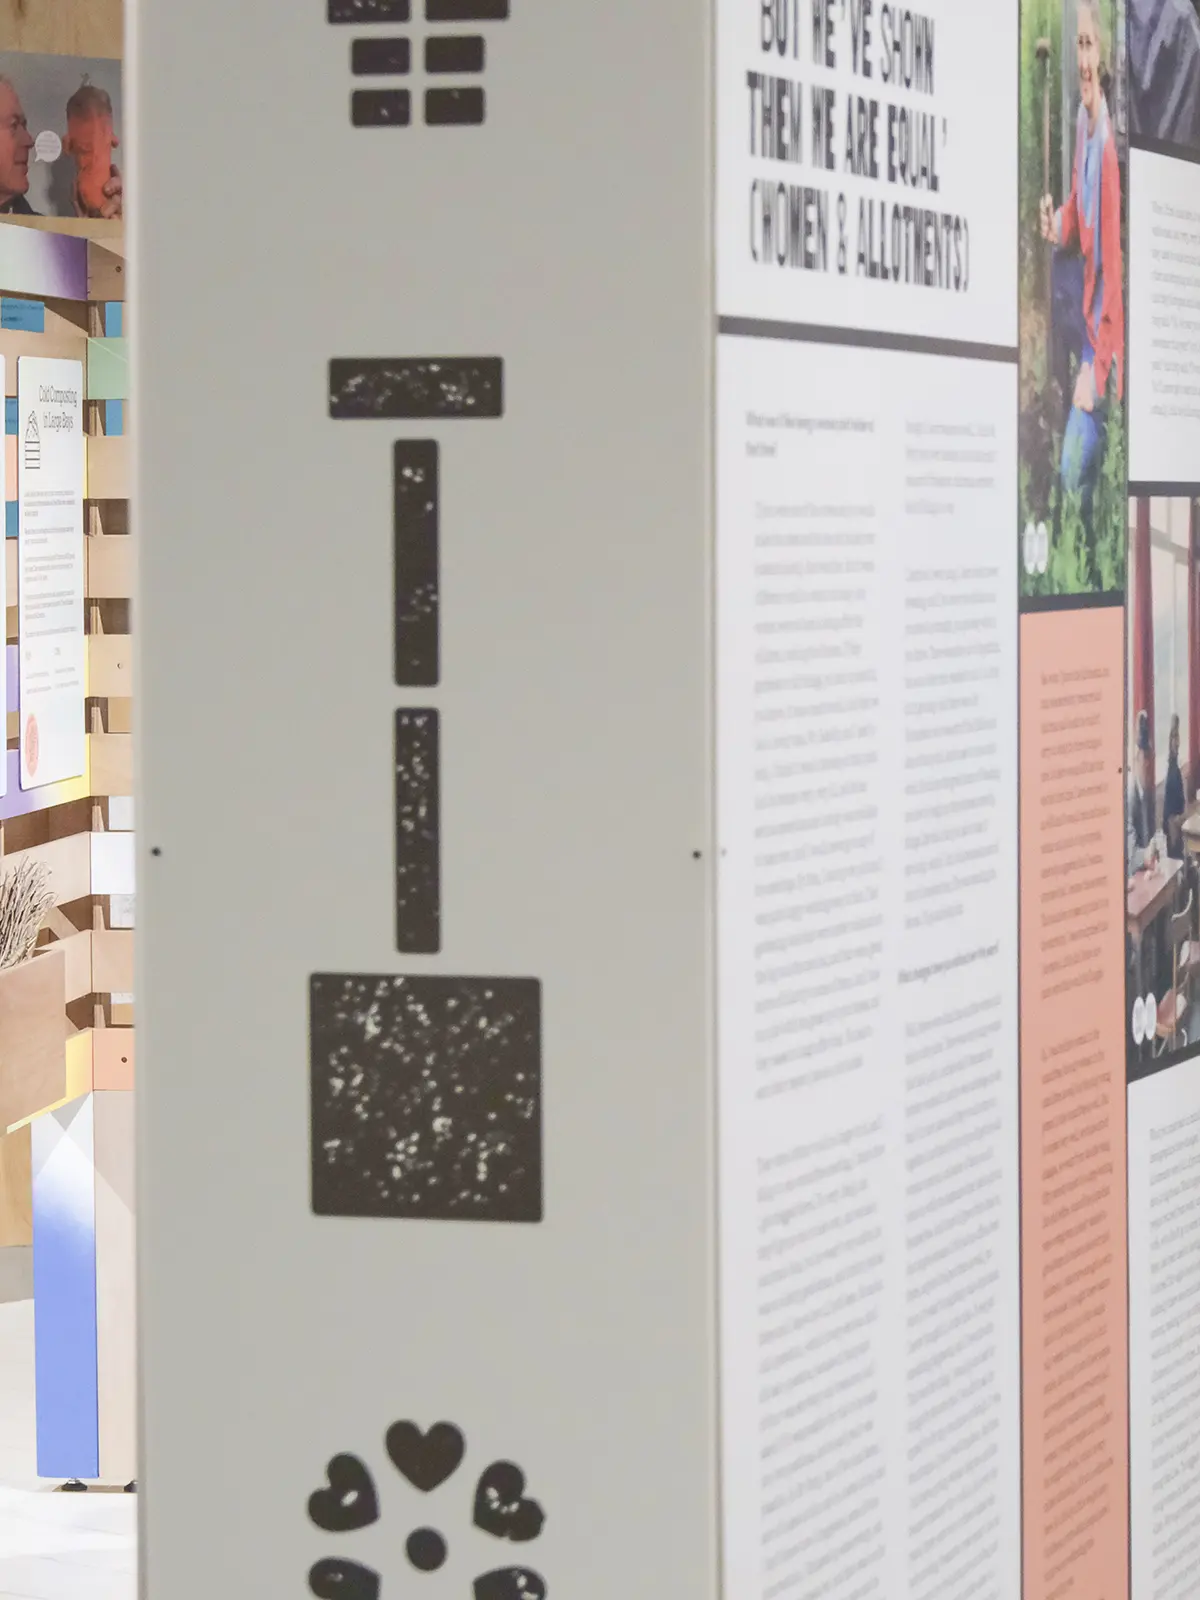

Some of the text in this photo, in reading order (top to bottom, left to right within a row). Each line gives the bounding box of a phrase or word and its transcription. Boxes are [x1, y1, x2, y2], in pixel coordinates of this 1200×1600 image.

[880, 3, 935, 95] SHOWN
[746, 70, 802, 165] THEM
[811, 84, 836, 171] WE
[844, 94, 880, 180] ARE
[749, 178, 828, 273] (WOMEN
[855, 197, 970, 294] ALLOTMENTS)
